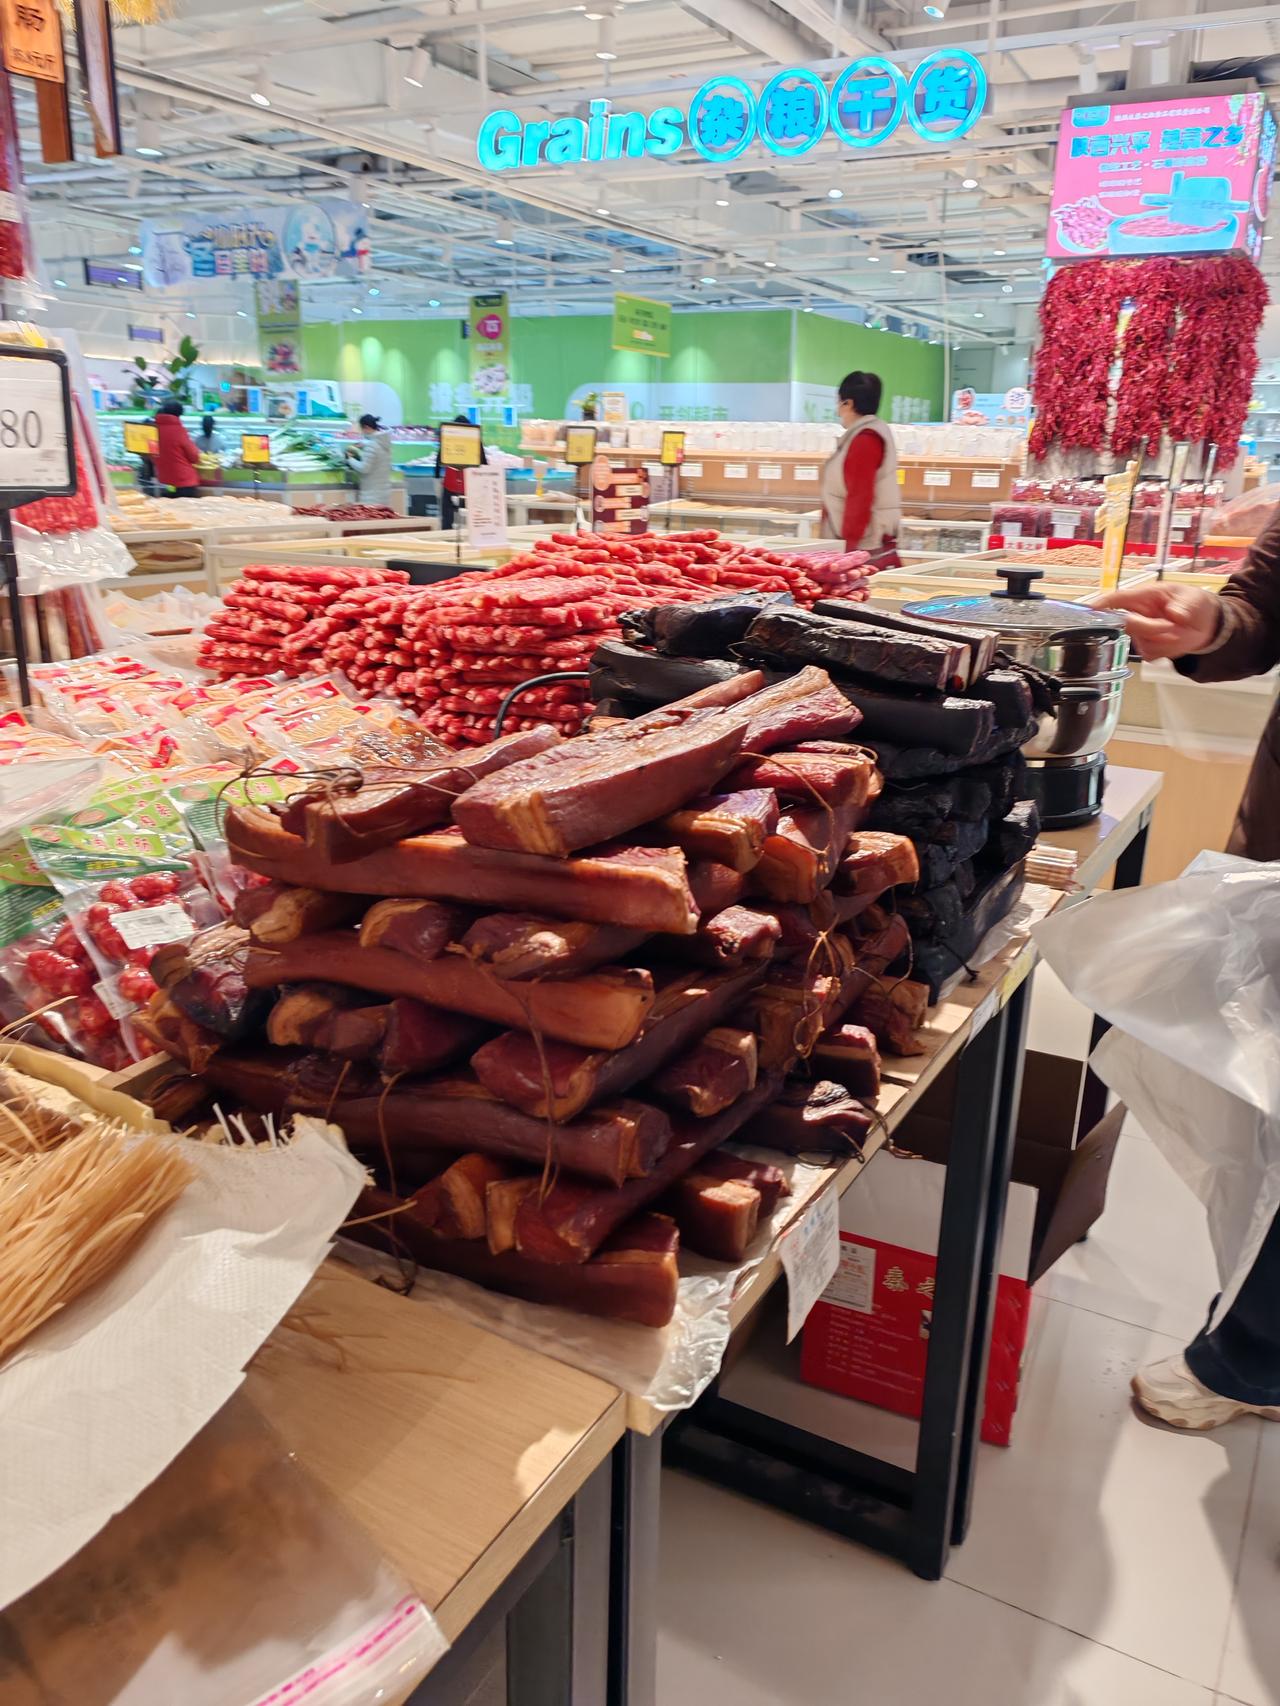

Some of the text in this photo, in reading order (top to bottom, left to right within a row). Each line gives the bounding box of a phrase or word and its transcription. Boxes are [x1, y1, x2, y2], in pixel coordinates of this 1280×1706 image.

[477, 62, 972, 171] Grains 杂粮干货
[0, 409, 43, 448] 80
